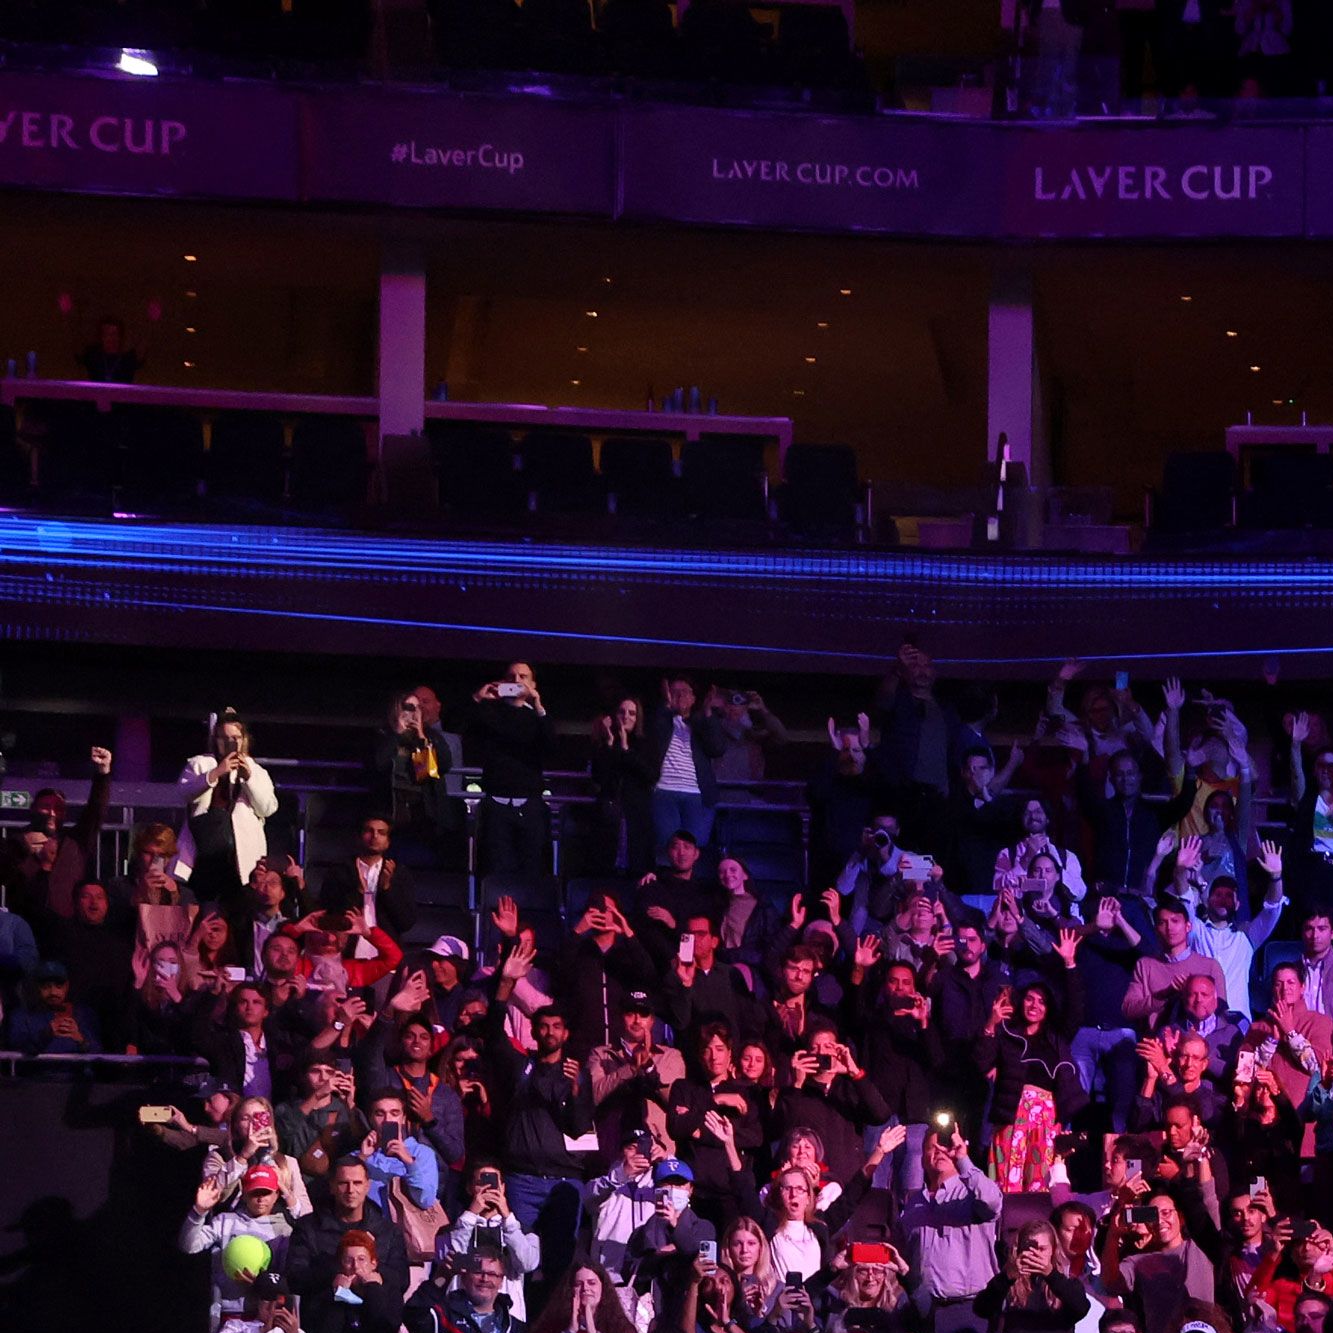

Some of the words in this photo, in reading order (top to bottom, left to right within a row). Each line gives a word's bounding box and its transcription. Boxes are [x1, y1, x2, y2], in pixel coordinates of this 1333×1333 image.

[90, 115, 187, 155] CUP
[391, 142, 525, 174] #LaverCup
[713, 159, 790, 182] LAVER
[797, 162, 919, 188] CUP.COM
[1035, 166, 1171, 200] LAVER
[1181, 164, 1273, 200] CUP
